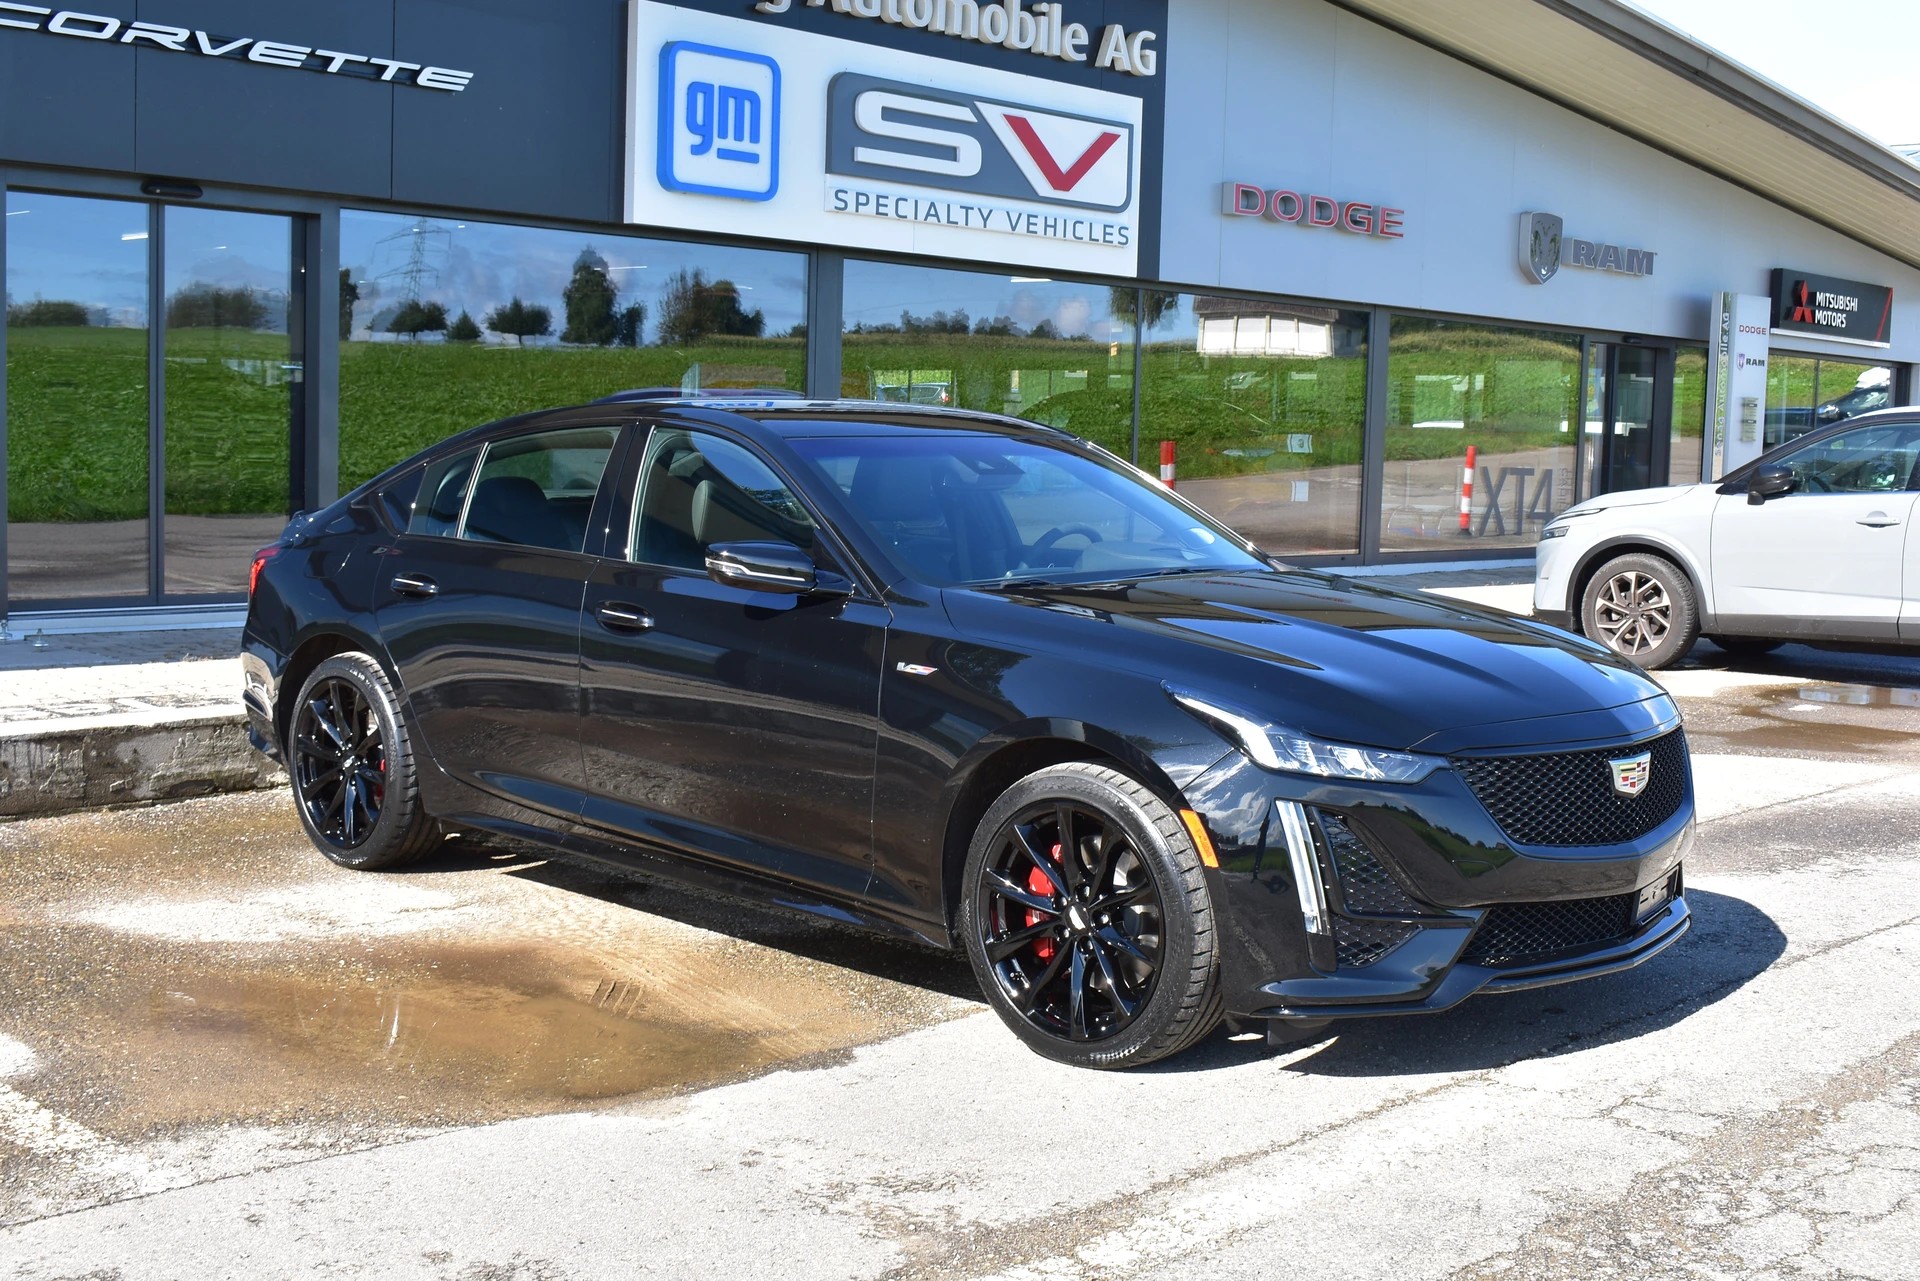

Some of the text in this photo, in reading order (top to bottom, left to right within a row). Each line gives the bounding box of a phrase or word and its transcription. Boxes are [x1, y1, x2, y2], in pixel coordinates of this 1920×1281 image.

[0, 2, 474, 91] CORVETTE
[806, 0, 1157, 76] omobile AG
[686, 81, 761, 157] gm
[854, 90, 1121, 193] SV
[833, 189, 1130, 246] SPECIALTY VEHICLES
[1232, 182, 1405, 238] DODGE
[1570, 236, 1656, 276] RAM
[1814, 309, 1847, 328] MOTORS
[1815, 291, 1859, 312] MITSUBISHI
[1738, 324, 1767, 336] DODGE
[1745, 358, 1765, 367] RAM
[1479, 466, 1554, 537] XT4
